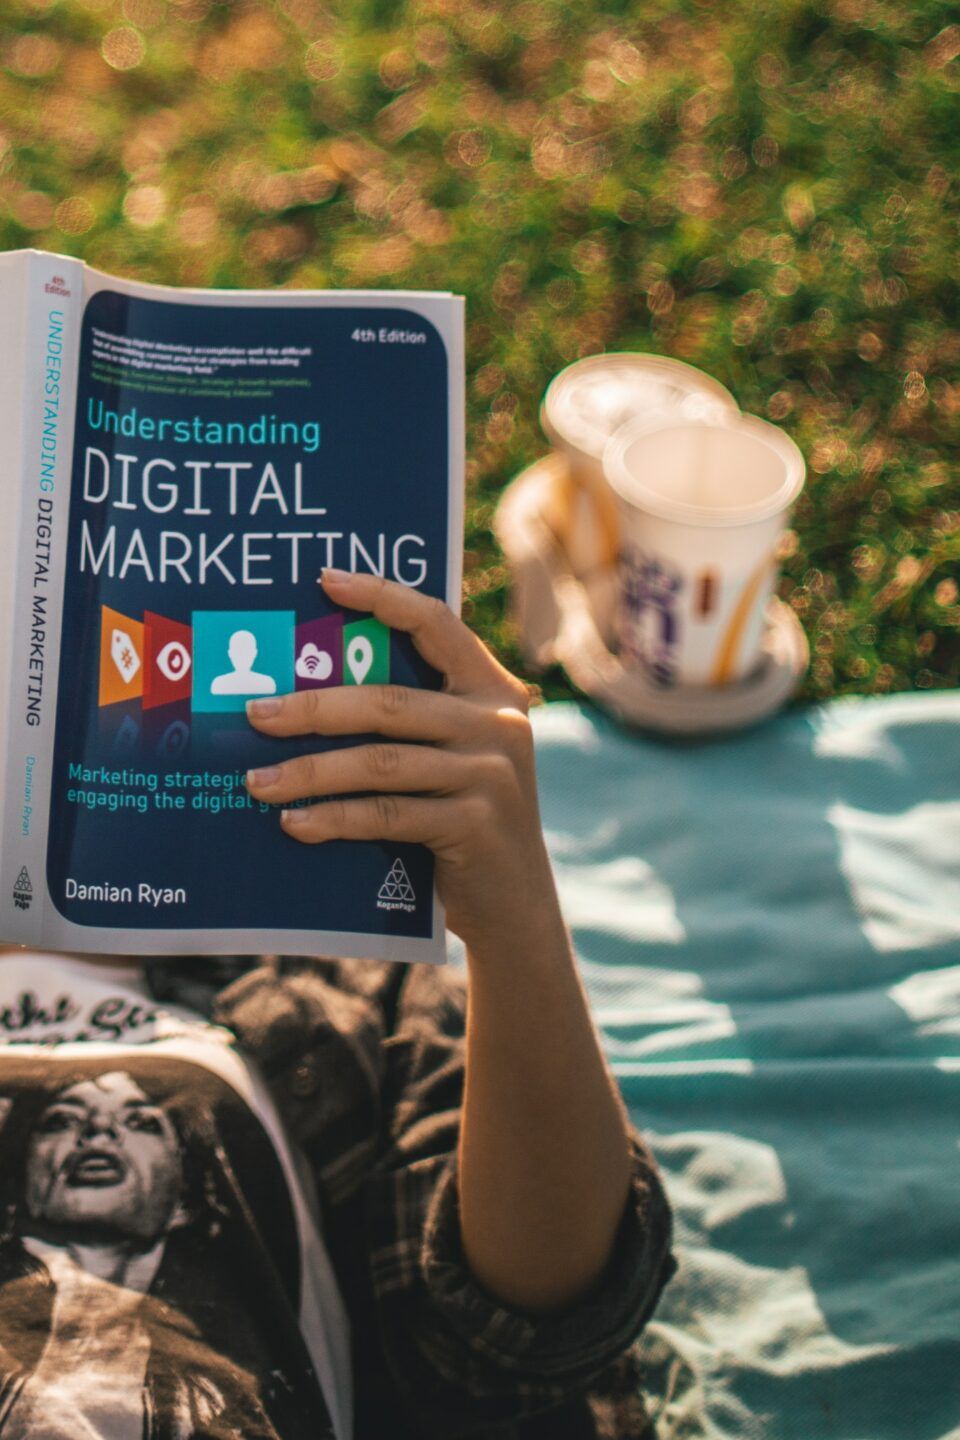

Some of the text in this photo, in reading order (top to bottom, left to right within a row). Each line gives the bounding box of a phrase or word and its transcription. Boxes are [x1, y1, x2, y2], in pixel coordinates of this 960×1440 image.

[351, 328, 426, 344] 4th Edition
[88, 398, 320, 452] Understanding
[83, 446, 327, 515] DIGITAL
[26, 310, 64, 726] UNDERSTANDING DIGITAL MARKETING
[80, 520, 428, 587] MARKETING
[22, 756, 36, 836] Damian Ryan
[67, 789, 148, 813] engaging
[154, 792, 185, 808] the
[192, 792, 252, 813] digital
[68, 762, 248, 792] Marketing strategi
[66, 878, 186, 907] Damian Ryan
